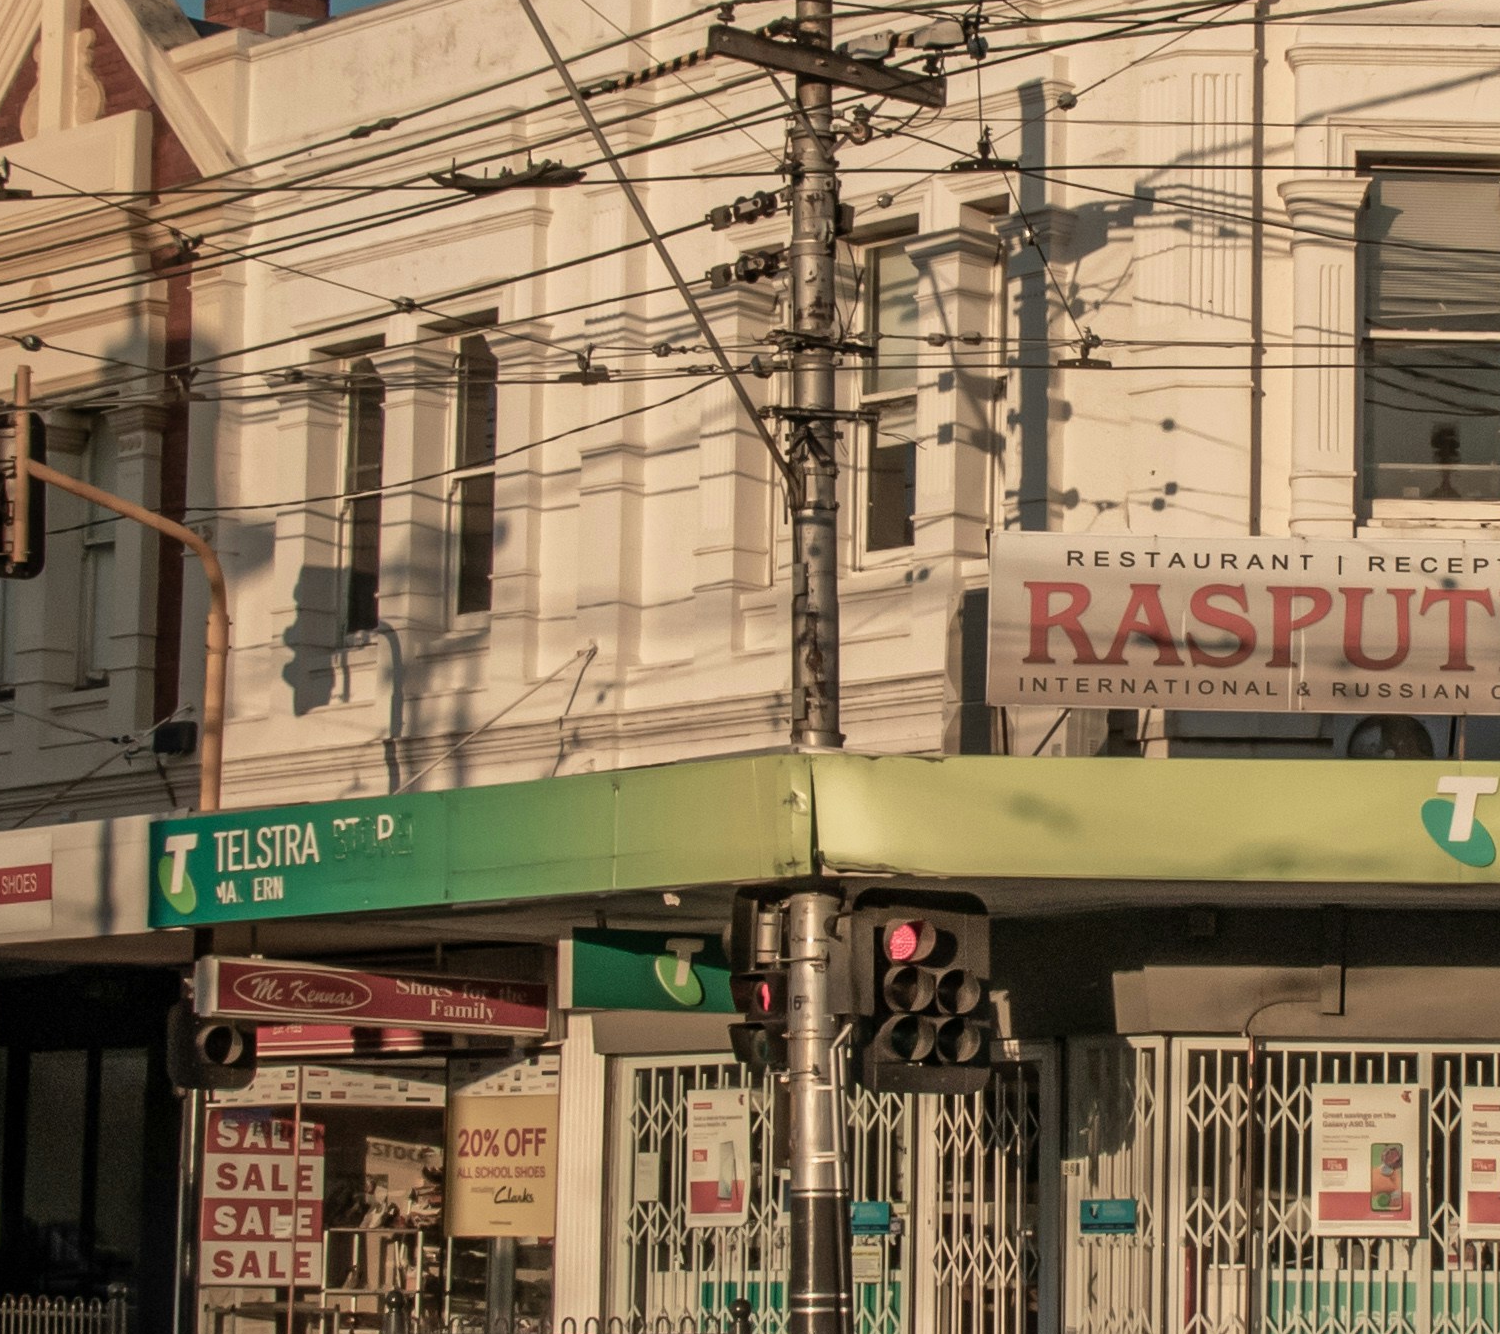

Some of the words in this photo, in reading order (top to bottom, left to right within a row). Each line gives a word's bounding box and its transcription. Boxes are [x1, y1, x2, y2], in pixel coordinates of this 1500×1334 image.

[1067, 551, 1314, 571] RESTAURANT
[1019, 677, 1279, 696] INTERNATIONAL
[1296, 682, 1311, 697] &
[1332, 682, 1471, 699] RUSSIAN
[213, 821, 321, 874] TELSTRA
[0, 872, 38, 897] SHOES
[291, 980, 356, 1006] Kennas
[395, 979, 454, 999] Shoes
[429, 997, 499, 1024] Family
[216, 1119, 316, 1151] SALE
[457, 1128, 500, 1158] 20%
[504, 1127, 548, 1157] OFF
[215, 1162, 314, 1193] SALE
[457, 1166, 474, 1179] ALL
[475, 1167, 513, 1179] SCHOOL
[515, 1166, 546, 1179] SHOES
[494, 1185, 535, 1205] Clarks
[212, 1249, 312, 1280] SALE
